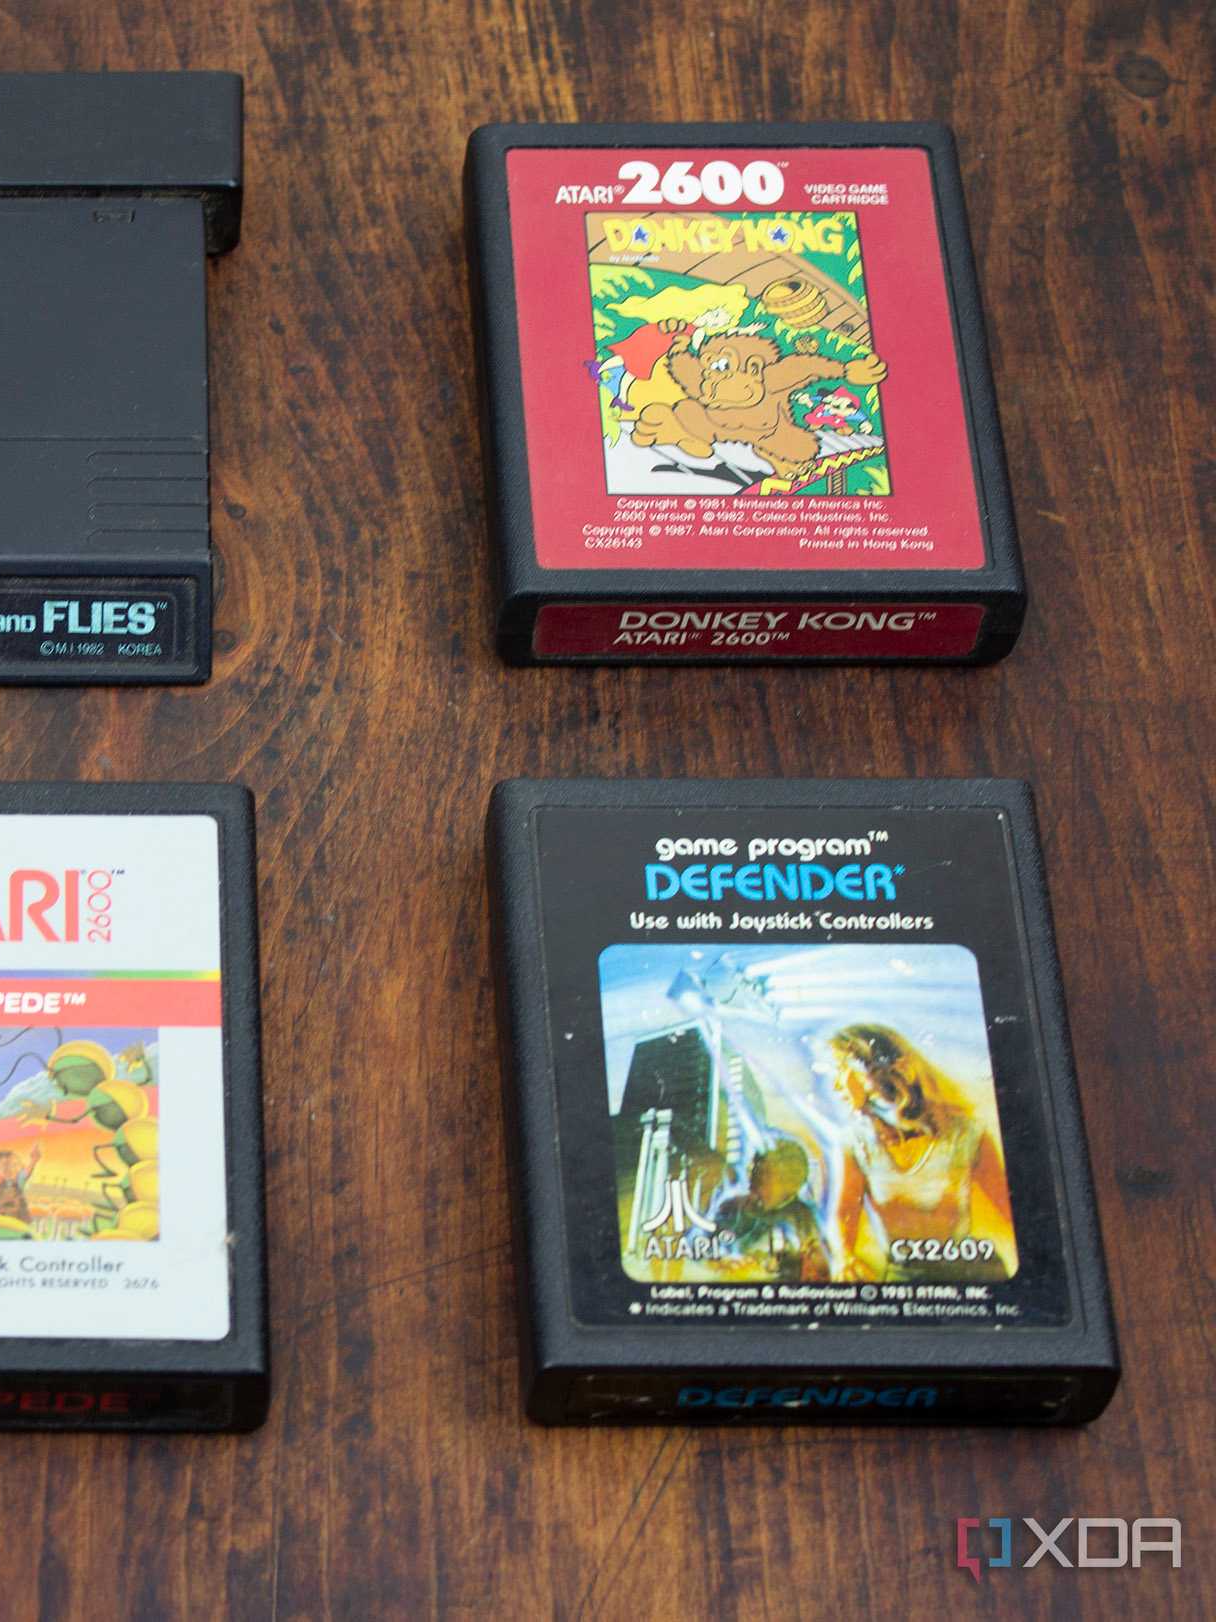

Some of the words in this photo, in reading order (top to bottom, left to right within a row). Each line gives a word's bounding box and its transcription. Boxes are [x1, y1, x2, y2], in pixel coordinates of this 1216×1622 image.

[804, 184, 846, 194] VIDEO
[848, 183, 888, 194] GAME
[811, 194, 889, 205] CARTRIDGE
[603, 219, 742, 253] DONKEY
[742, 219, 843, 254] KONG
[616, 498, 678, 510] Copyright
[733, 498, 789, 509] Nintendo
[791, 499, 804, 509] of
[807, 499, 861, 509] America
[649, 512, 696, 522] version
[752, 511, 797, 522] Coleco
[582, 523, 643, 537] Copyright
[699, 525, 728, 536] Atari
[814, 525, 831, 536] All
[834, 526, 869, 538] rights
[799, 538, 844, 549] Printed
[847, 539, 859, 549] in
[863, 538, 897, 550] Hong
[900, 539, 934, 551] Kong
[618, 610, 789, 631] DONKEY
[117, 642, 162, 656] KOREA
[655, 838, 738, 862] game
[630, 911, 669, 930] Use
[676, 911, 722, 930] with
[730, 911, 812, 933] Joystick
[819, 911, 933, 930] Controllers
[891, 1238, 994, 1262] CX2609
[19, 1255, 124, 1272] Controller
[41, 1277, 109, 1288] RESERVED
[698, 1286, 759, 1301] Program
[778, 1286, 856, 1299] Audiovisual
[645, 1303, 714, 1315] Indicates
[732, 1302, 810, 1315] Trademark
[814, 1302, 830, 1316] of
[833, 1302, 899, 1316] Williams
[677, 1386, 939, 1409] DEFENDER
